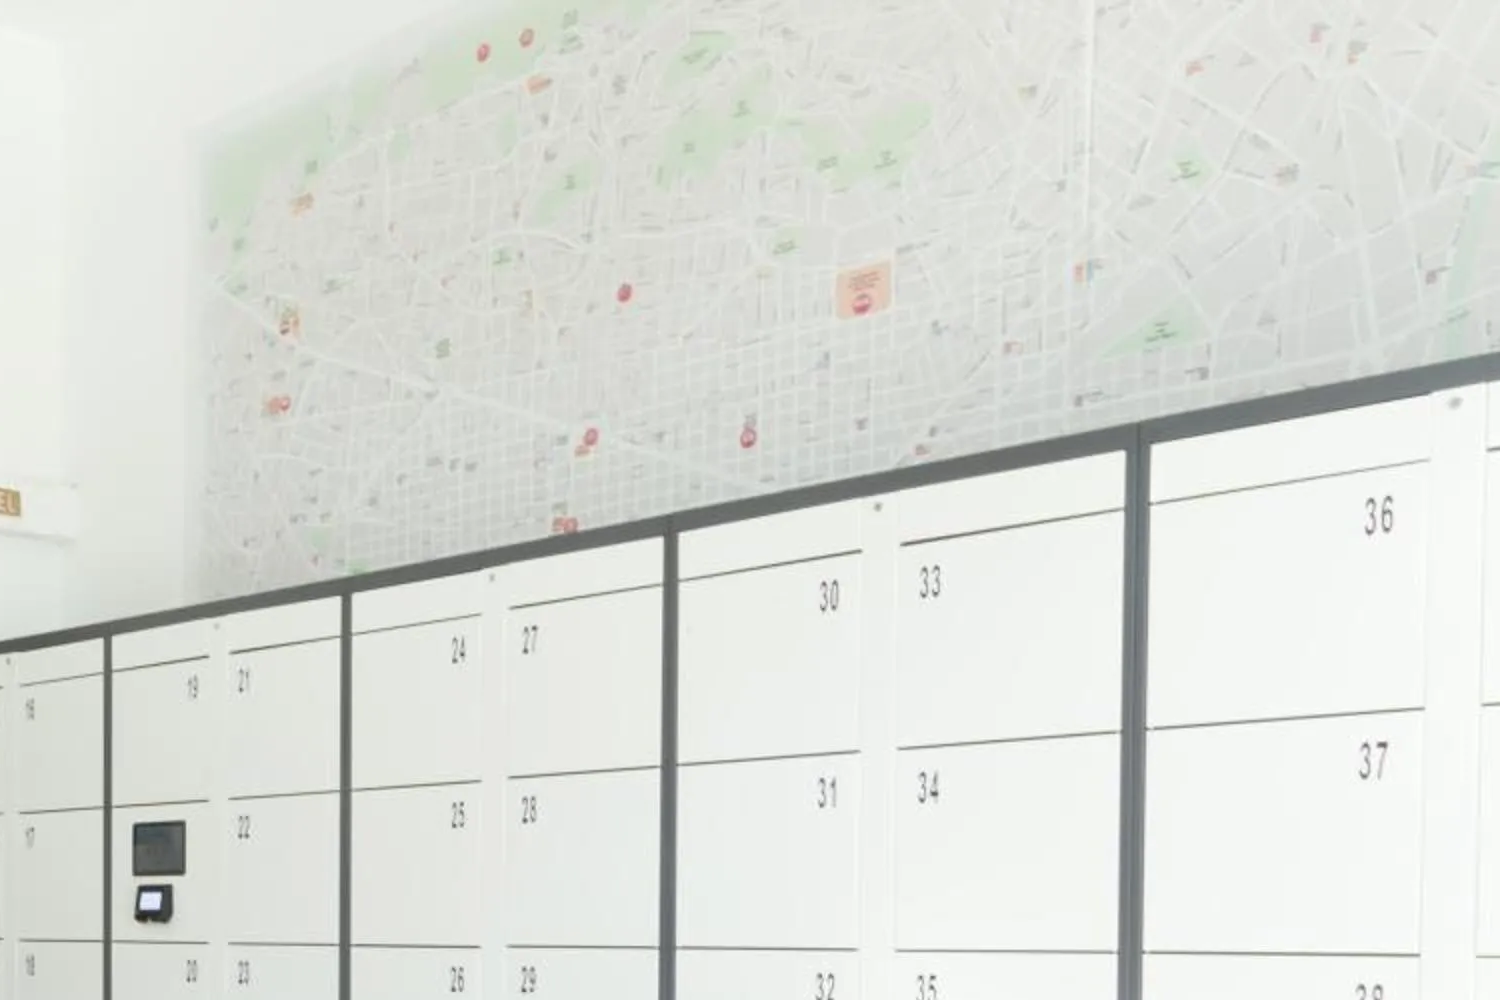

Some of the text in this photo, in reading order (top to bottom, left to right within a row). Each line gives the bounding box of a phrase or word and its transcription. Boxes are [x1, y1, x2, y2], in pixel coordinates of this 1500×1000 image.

[1364, 495, 1394, 537] 36
[819, 579, 839, 613] 30
[919, 564, 941, 599] 33
[451, 636, 466, 665] 24
[521, 624, 539, 655] 27
[1358, 740, 1389, 781] 37
[817, 777, 837, 809] 31
[918, 771, 940, 804] 34
[451, 801, 465, 829] 25
[521, 795, 537, 825] 28
[237, 815, 251, 840] 22
[450, 966, 465, 993] 26
[520, 965, 537, 994] 29
